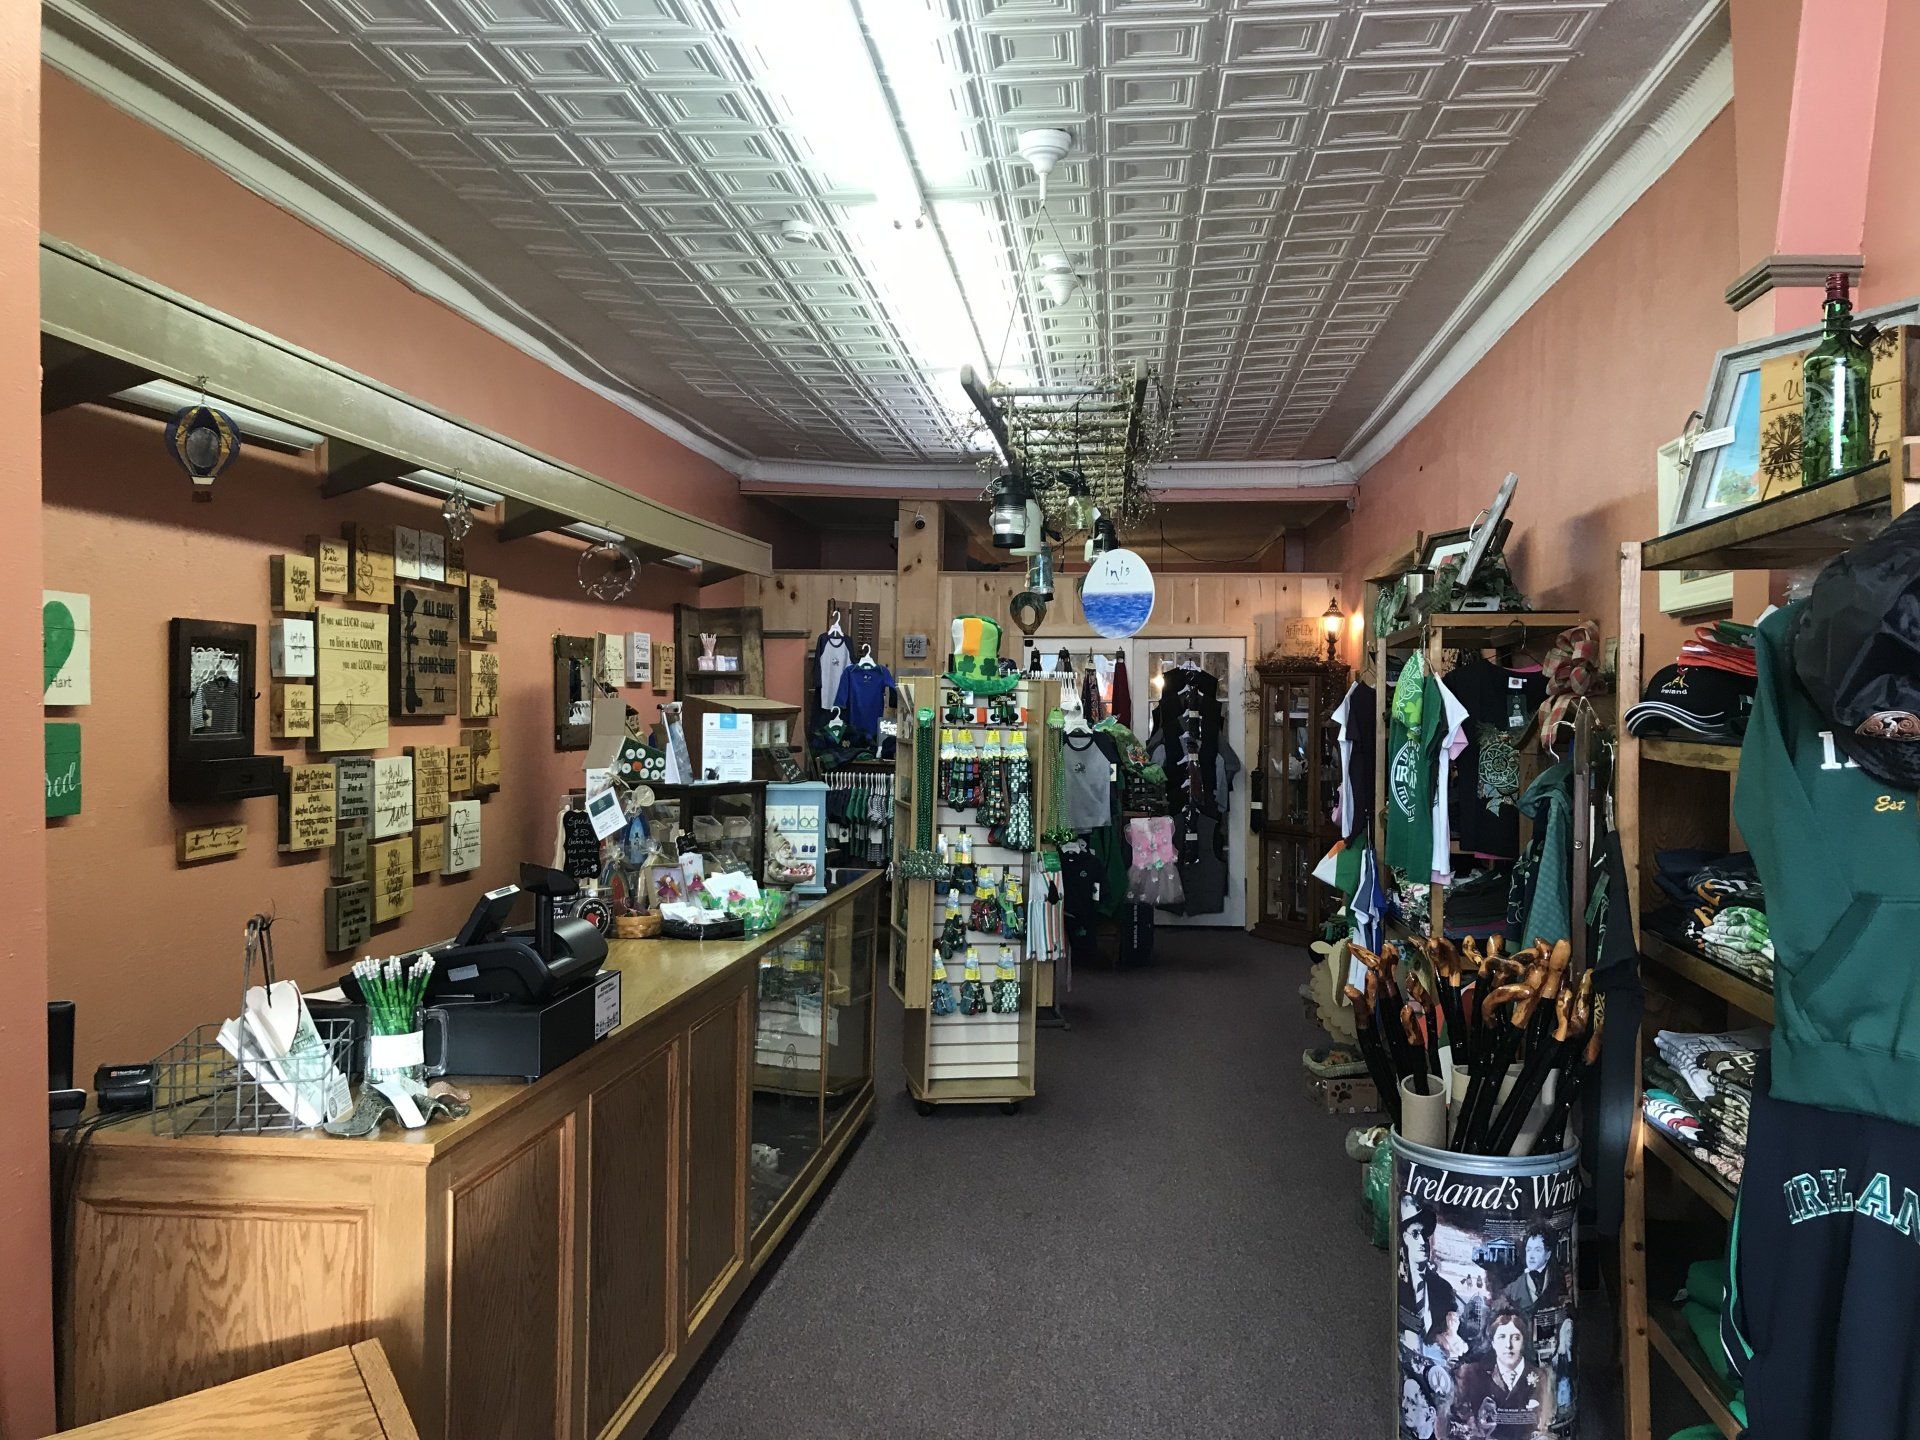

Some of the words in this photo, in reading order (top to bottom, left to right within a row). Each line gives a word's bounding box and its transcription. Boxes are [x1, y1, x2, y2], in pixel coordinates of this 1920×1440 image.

[1105, 560, 1131, 581] inis
[423, 599, 435, 616] ALL
[436, 602, 454, 619] GAVE
[326, 617, 334, 627] you
[344, 617, 360, 628] LUCKY
[360, 621, 375, 630] enough
[329, 639, 336, 647] to
[336, 638, 345, 648] live
[345, 638, 351, 647] in
[351, 640, 359, 649] the
[428, 628, 449, 647] SOME
[342, 661, 350, 670] you
[350, 661, 358, 669] are
[358, 659, 372, 671] LUCKY
[418, 656, 438, 674] SOME
[438, 657, 456, 675] GAVE
[433, 686, 445, 703] ALL
[340, 758, 371, 769] Everything
[343, 771, 368, 781] Happens
[347, 784, 357, 792] For
[357, 783, 364, 791] A
[1874, 795, 1906, 812] Est
[573, 829, 590, 837] $50
[1404, 1161, 1523, 1211] Ireland's
[1530, 1169, 1581, 1210] Writ
